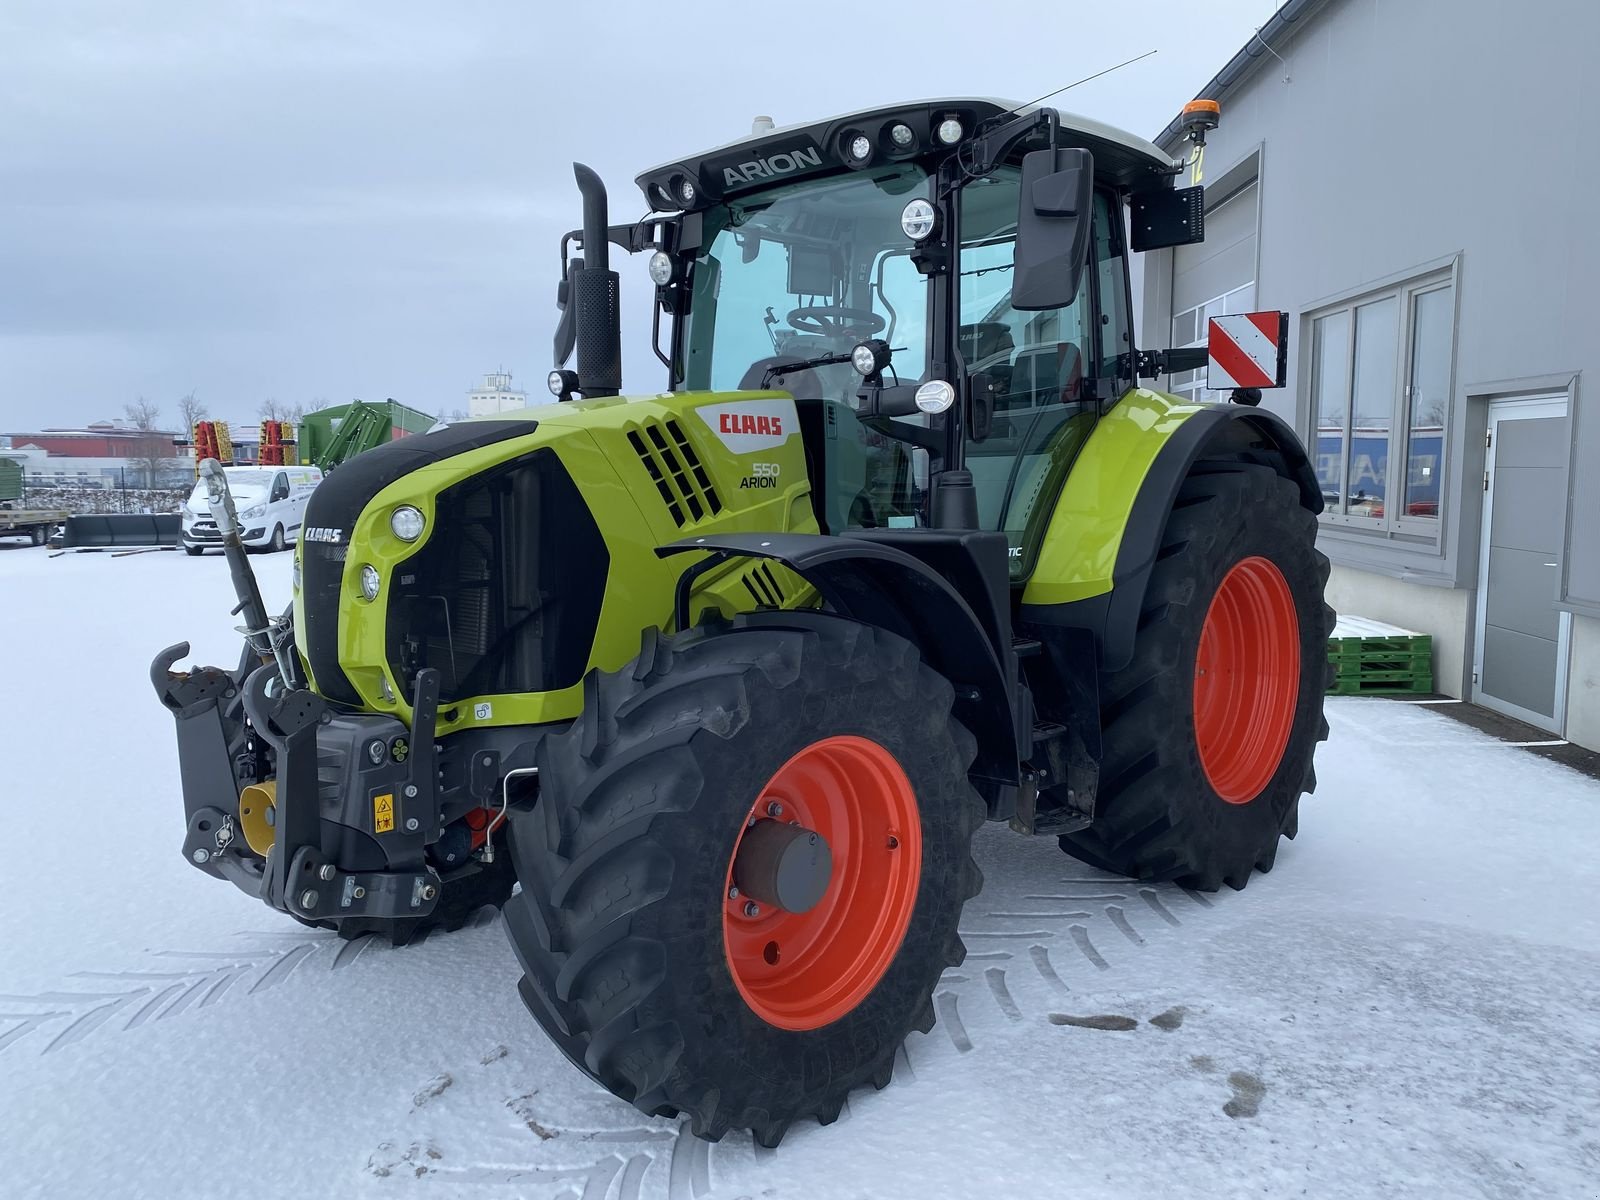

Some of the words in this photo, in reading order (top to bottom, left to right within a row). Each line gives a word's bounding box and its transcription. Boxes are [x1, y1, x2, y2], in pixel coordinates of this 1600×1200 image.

[722, 146, 823, 187] ARION
[719, 413, 782, 436] CLAAS
[752, 463, 781, 477] 550
[739, 477, 777, 489] ARION
[304, 527, 342, 543] CLAAS
[1008, 546, 1023, 557] TIC
